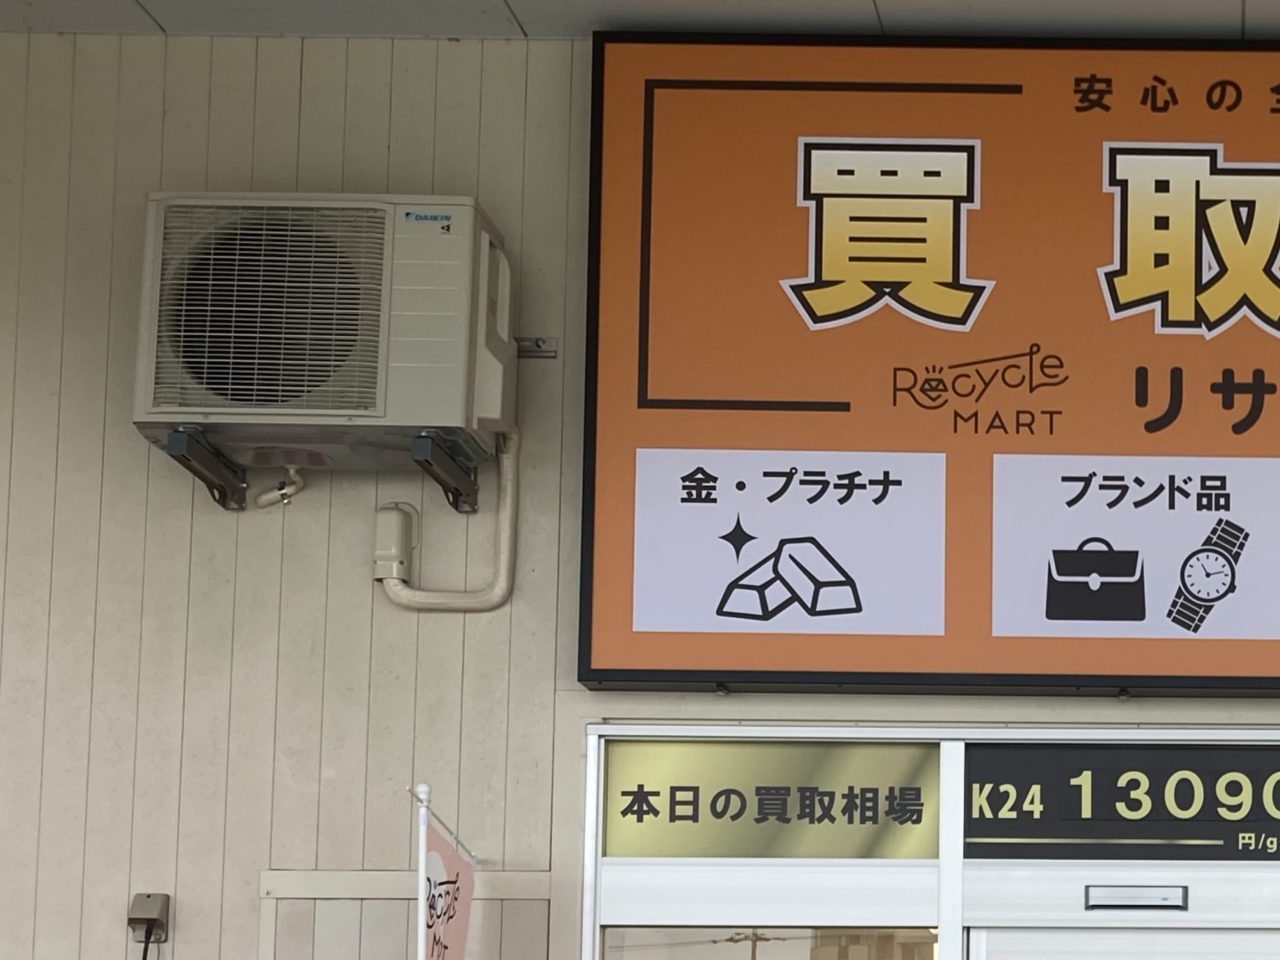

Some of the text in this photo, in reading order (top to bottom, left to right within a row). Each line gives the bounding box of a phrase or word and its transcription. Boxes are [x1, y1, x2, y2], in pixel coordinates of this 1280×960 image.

[892, 343, 1070, 410] Recycle
[953, 410, 1063, 436] MART
[680, 467, 903, 505] 金・プラチナ
[1060, 473, 1232, 512] ブランド品
[620, 785, 925, 827] 本日の買取相場
[972, 781, 1044, 822] K24
